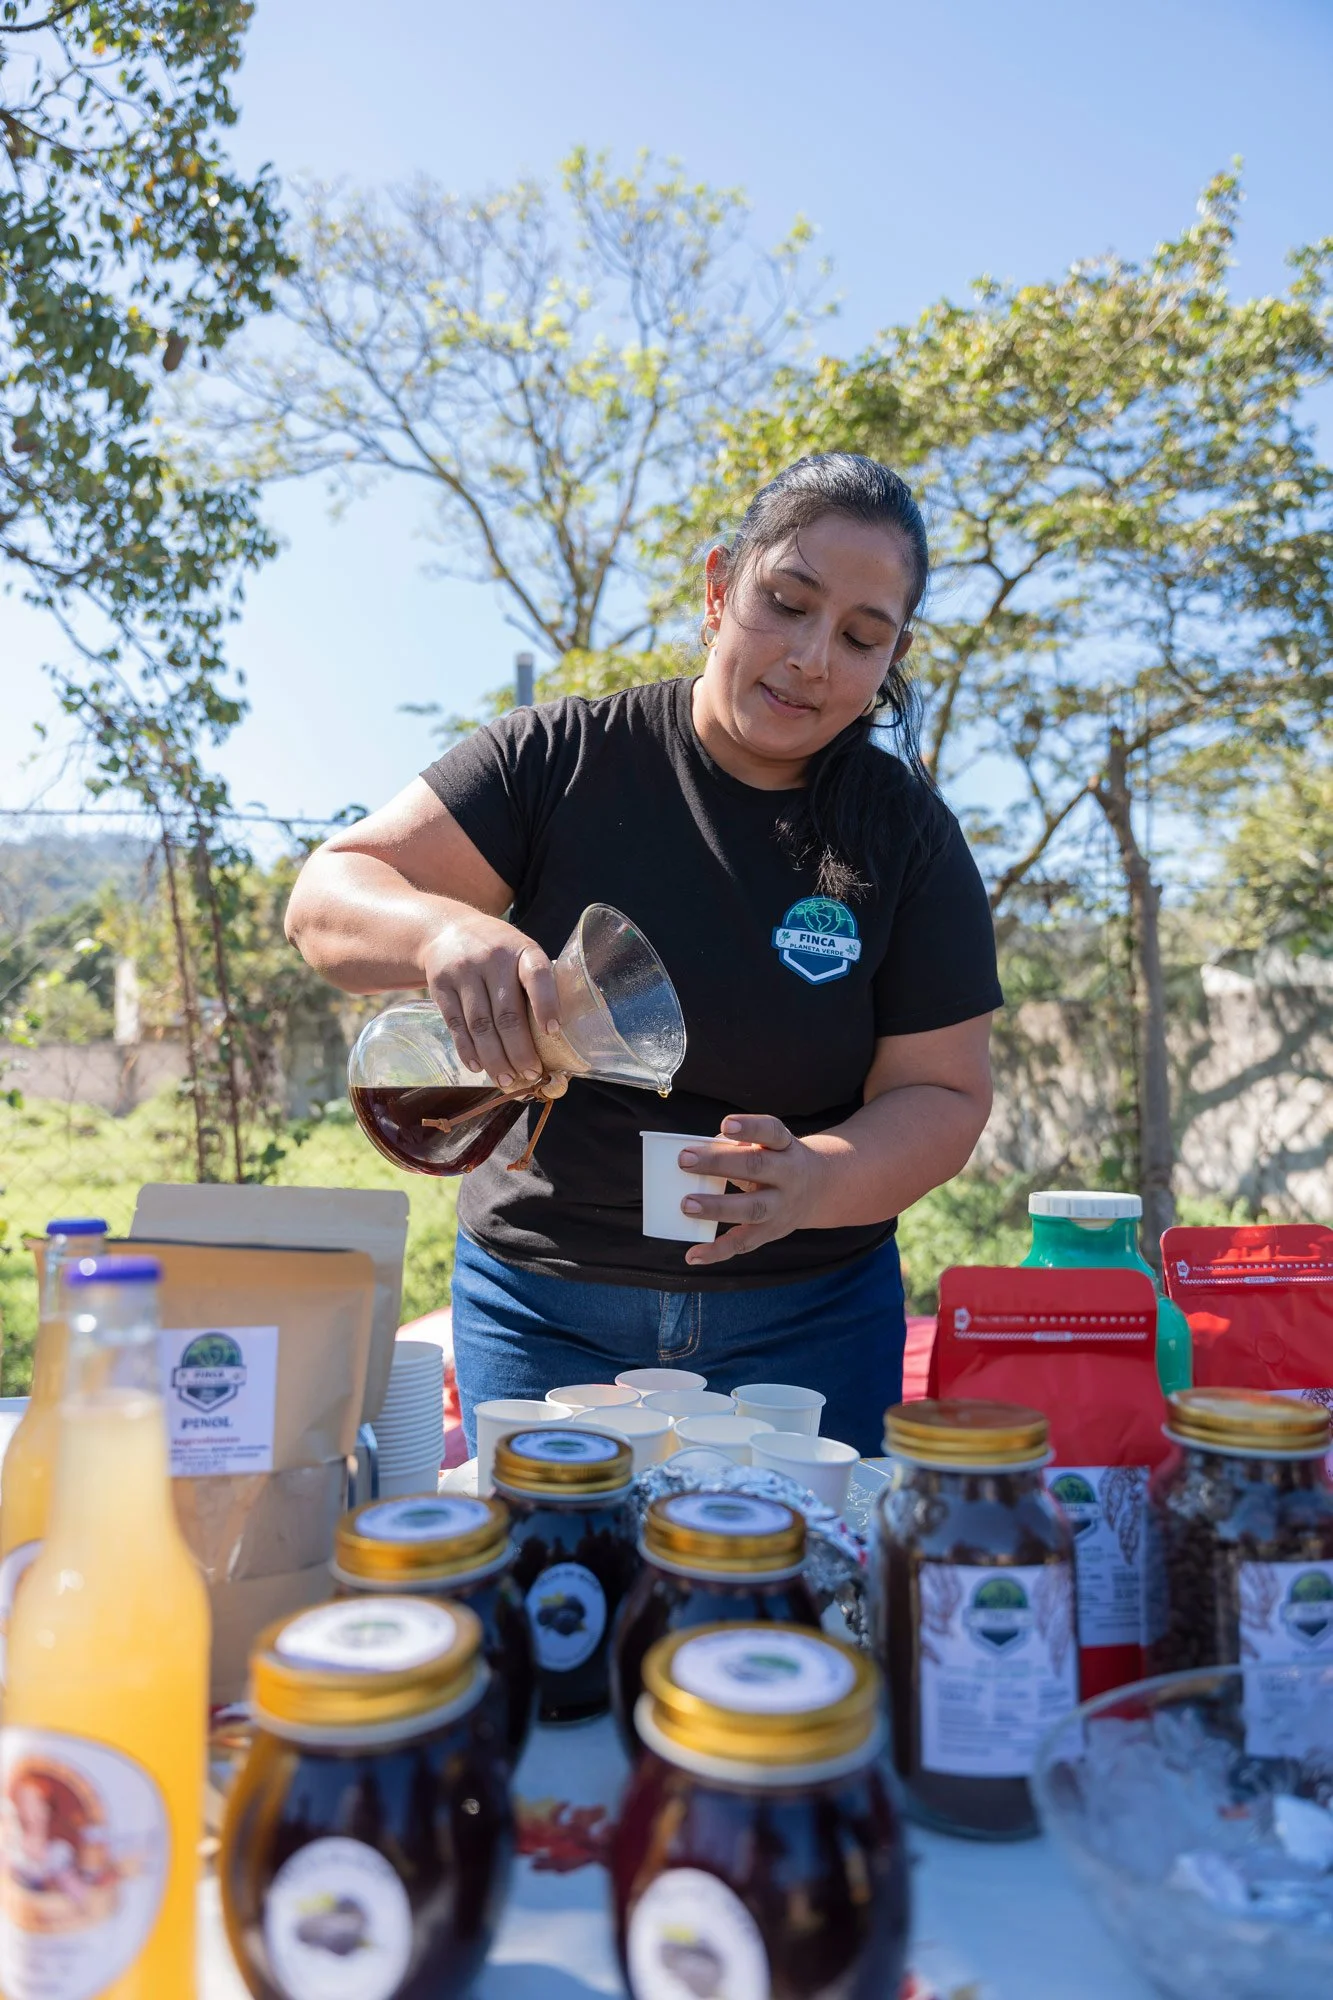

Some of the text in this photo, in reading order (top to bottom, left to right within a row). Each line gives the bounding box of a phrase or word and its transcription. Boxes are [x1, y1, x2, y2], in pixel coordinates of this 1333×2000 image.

[799, 933, 836, 948] FINCA
[789, 943, 844, 957] PLANETA VERDE
[181, 1415, 232, 1430] PINOL
